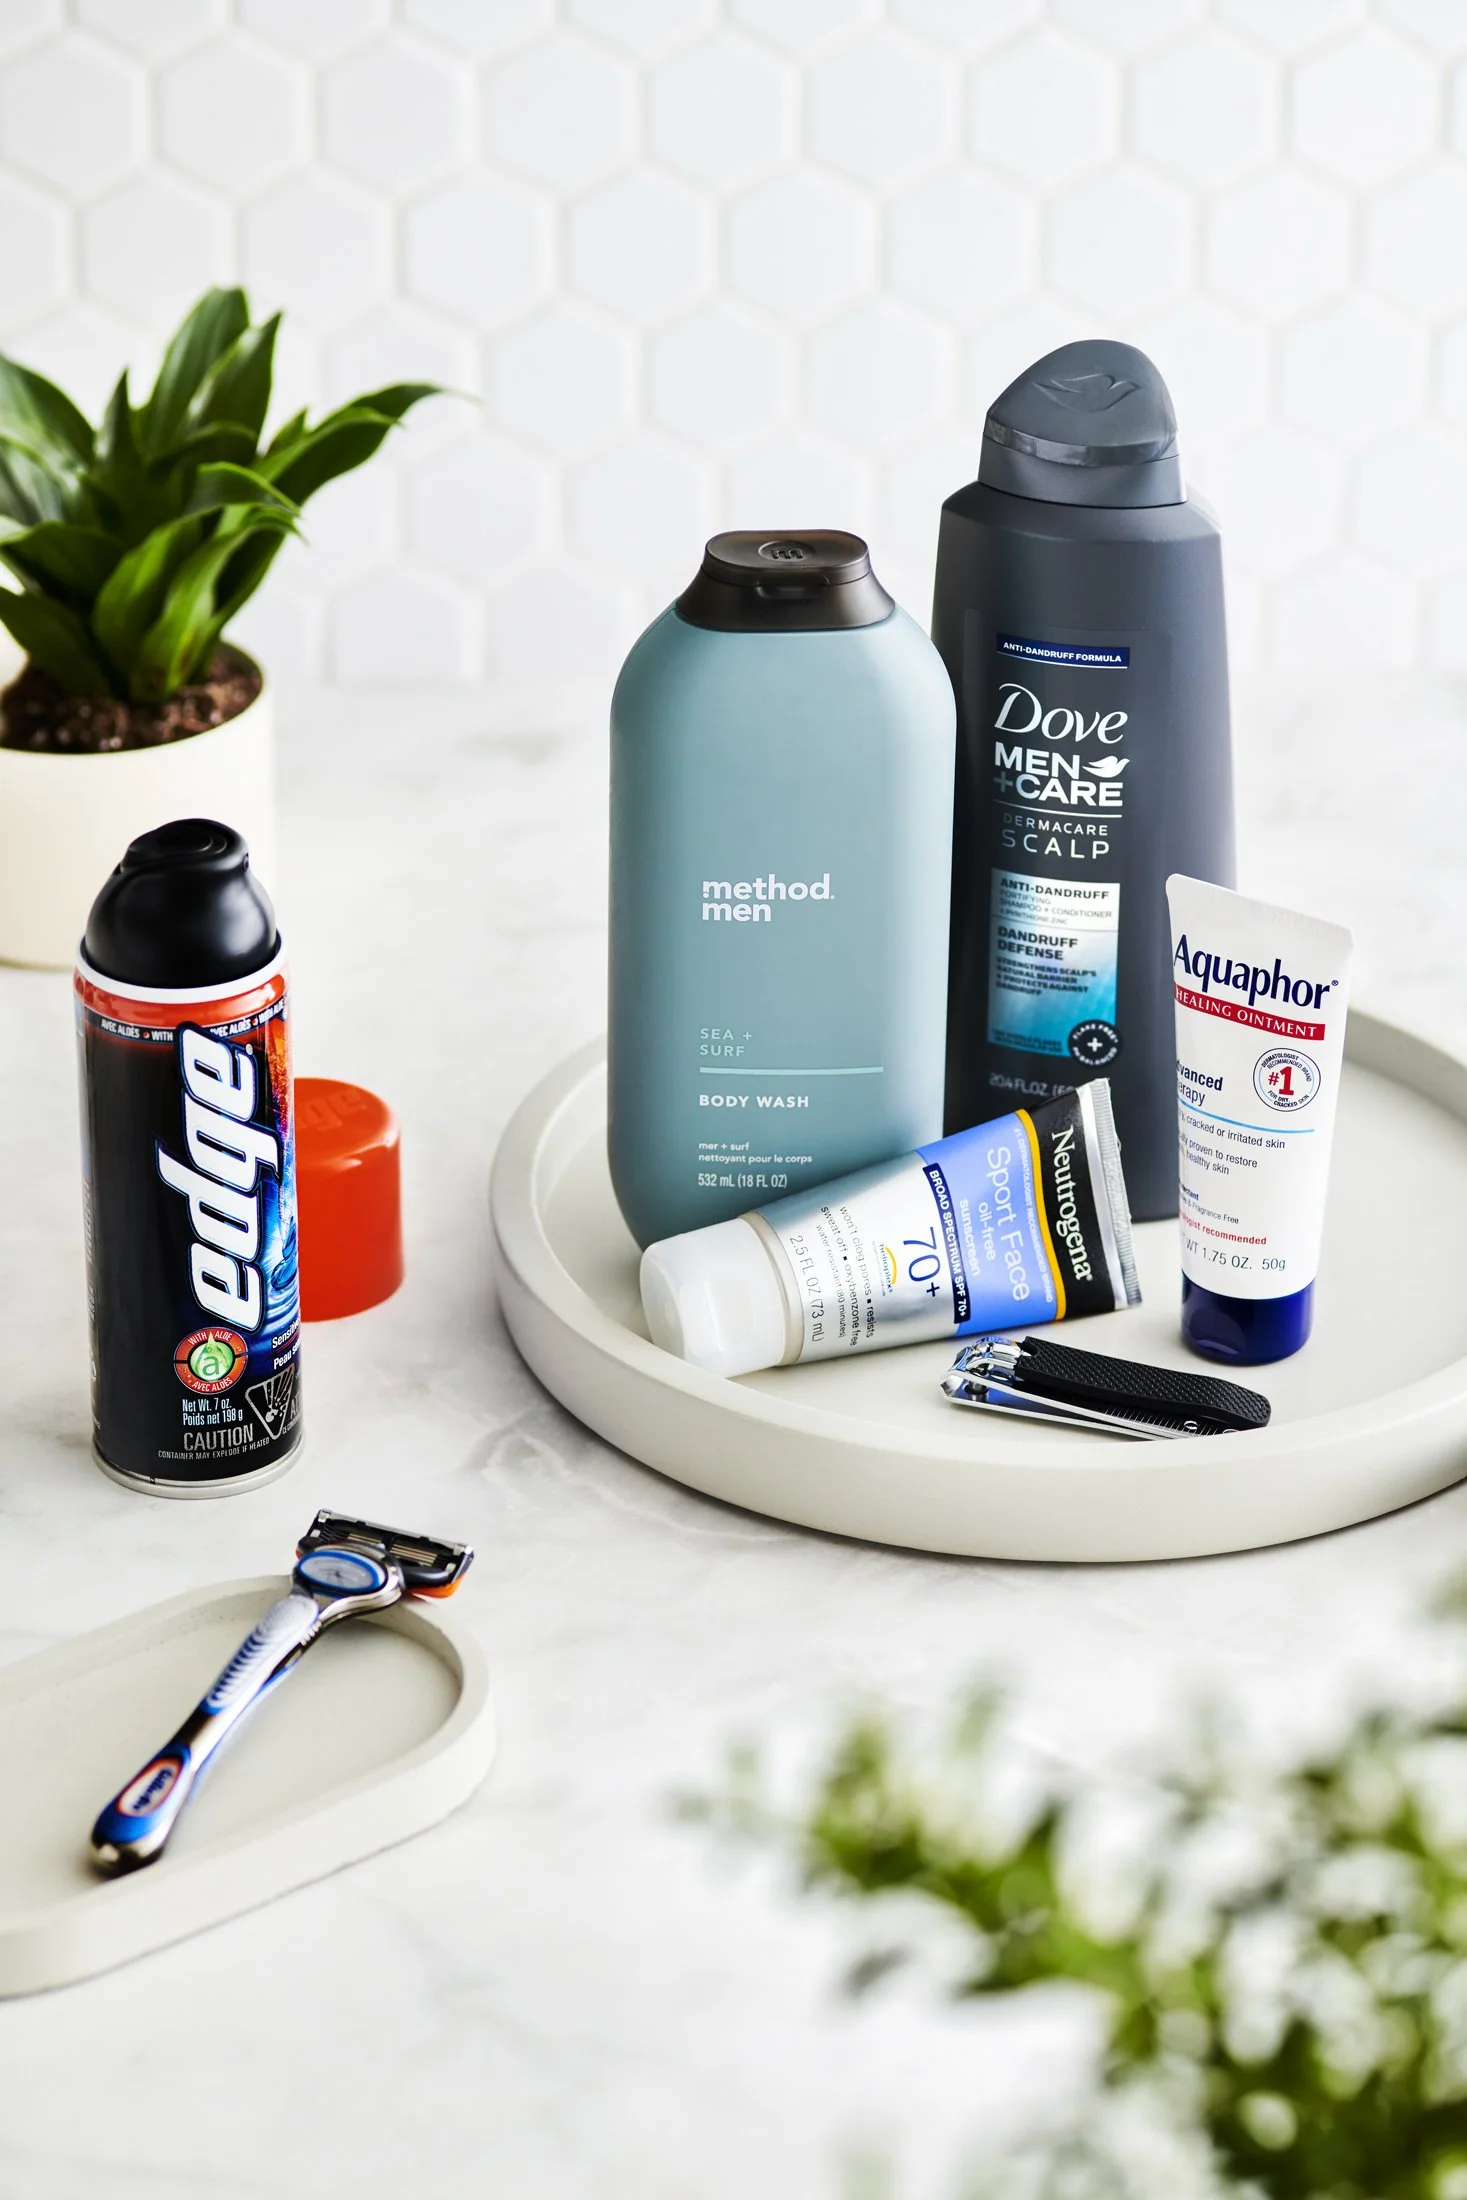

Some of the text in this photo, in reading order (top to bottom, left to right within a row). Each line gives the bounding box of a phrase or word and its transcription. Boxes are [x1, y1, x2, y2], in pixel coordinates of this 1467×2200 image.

[1003, 641, 1122, 663] ANTI-DANDRUFF FORMULA
[994, 683, 1129, 744] Dove
[995, 741, 1080, 780] MEN
[1003, 812, 1108, 836] DERMACARE
[1002, 829, 1109, 860] SCALP
[1000, 878, 1110, 900] ANTI-DANDRUFF
[702, 902, 772, 922] men
[1000, 898, 1042, 913] SHAMPOO
[1051, 907, 1112, 918] CONDITIONER
[998, 926, 1078, 948] DANDRUFF
[998, 939, 1064, 960] DEFENSE
[1050, 982, 1089, 994] AGAINST
[1175, 989, 1317, 1038] HEALING OINTMENT
[100, 1018, 117, 1034] AVEC
[151, 1030, 173, 1042] WITH
[700, 1028, 752, 1041] SEA +
[700, 1044, 745, 1057] SURF
[1261, 1052, 1299, 1068] DERMATOLOGIST
[1266, 1058, 1312, 1083] RECOMMENDED BRAND
[1268, 1066, 1295, 1096] #1
[699, 1094, 809, 1108] BODY WASH
[1268, 1090, 1278, 1100] FOR
[1273, 1094, 1310, 1108] CRACKED SKIN
[1186, 1115, 1215, 1134] cracked
[1216, 1128, 1226, 1138] or
[1227, 1129, 1263, 1147] irritated
[1266, 1137, 1286, 1149] skin
[699, 1142, 718, 1151] mer
[730, 1142, 750, 1151] surf
[1188, 1139, 1213, 1157] proven
[1215, 1149, 1224, 1160] to
[1226, 1154, 1258, 1169] restore
[698, 1154, 813, 1165] nettoyant pour le corps
[1186, 1149, 1211, 1170] healthy
[1212, 1162, 1230, 1176] skin
[158, 1027, 279, 1331] edge
[698, 1173, 788, 1189] 532 mL (18 FL OZ)
[986, 1146, 1030, 1301] Sport Face
[1017, 1137, 1033, 1206] DERMATOLOGIST
[1026, 1206, 1047, 1271] RECOMMENDED
[1041, 1272, 1054, 1303] BRAND
[1192, 1201, 1222, 1220] Fragrance
[1223, 1214, 1240, 1225] Free
[929, 1169, 967, 1317] BROAD SPECTRUM SPF 70+
[959, 1198, 981, 1277] sunscreen
[978, 1202, 997, 1261] oil-free
[1202, 1225, 1267, 1245] recommended
[820, 1206, 841, 1236] sweat
[836, 1237, 849, 1252] off
[844, 1263, 860, 1322] oxybenzone
[903, 1226, 941, 1298] 70+
[1202, 1246, 1227, 1266] 1.75
[1231, 1255, 1253, 1270] OZ.
[1262, 1258, 1286, 1272] 50g
[816, 1224, 830, 1248] water
[826, 1248, 842, 1288] resistant
[838, 1304, 848, 1339] minutes)
[839, 1206, 877, 1339] won't clog pores resists
[790, 1235, 826, 1343] 2.5 FL OZ (73 mL)
[188, 1331, 233, 1346] WITH ALOE
[202, 1355, 220, 1377] a
[273, 1349, 292, 1370] Peau
[192, 1380, 211, 1392] AVEC
[182, 1397, 232, 1412] Net Wt. 7 oz.
[182, 1408, 244, 1426] Poids net 198 g
[158, 1436, 270, 1460] CONTAINER MAY EXPLODE IF HEATED
[183, 1423, 254, 1452] CAUTION
